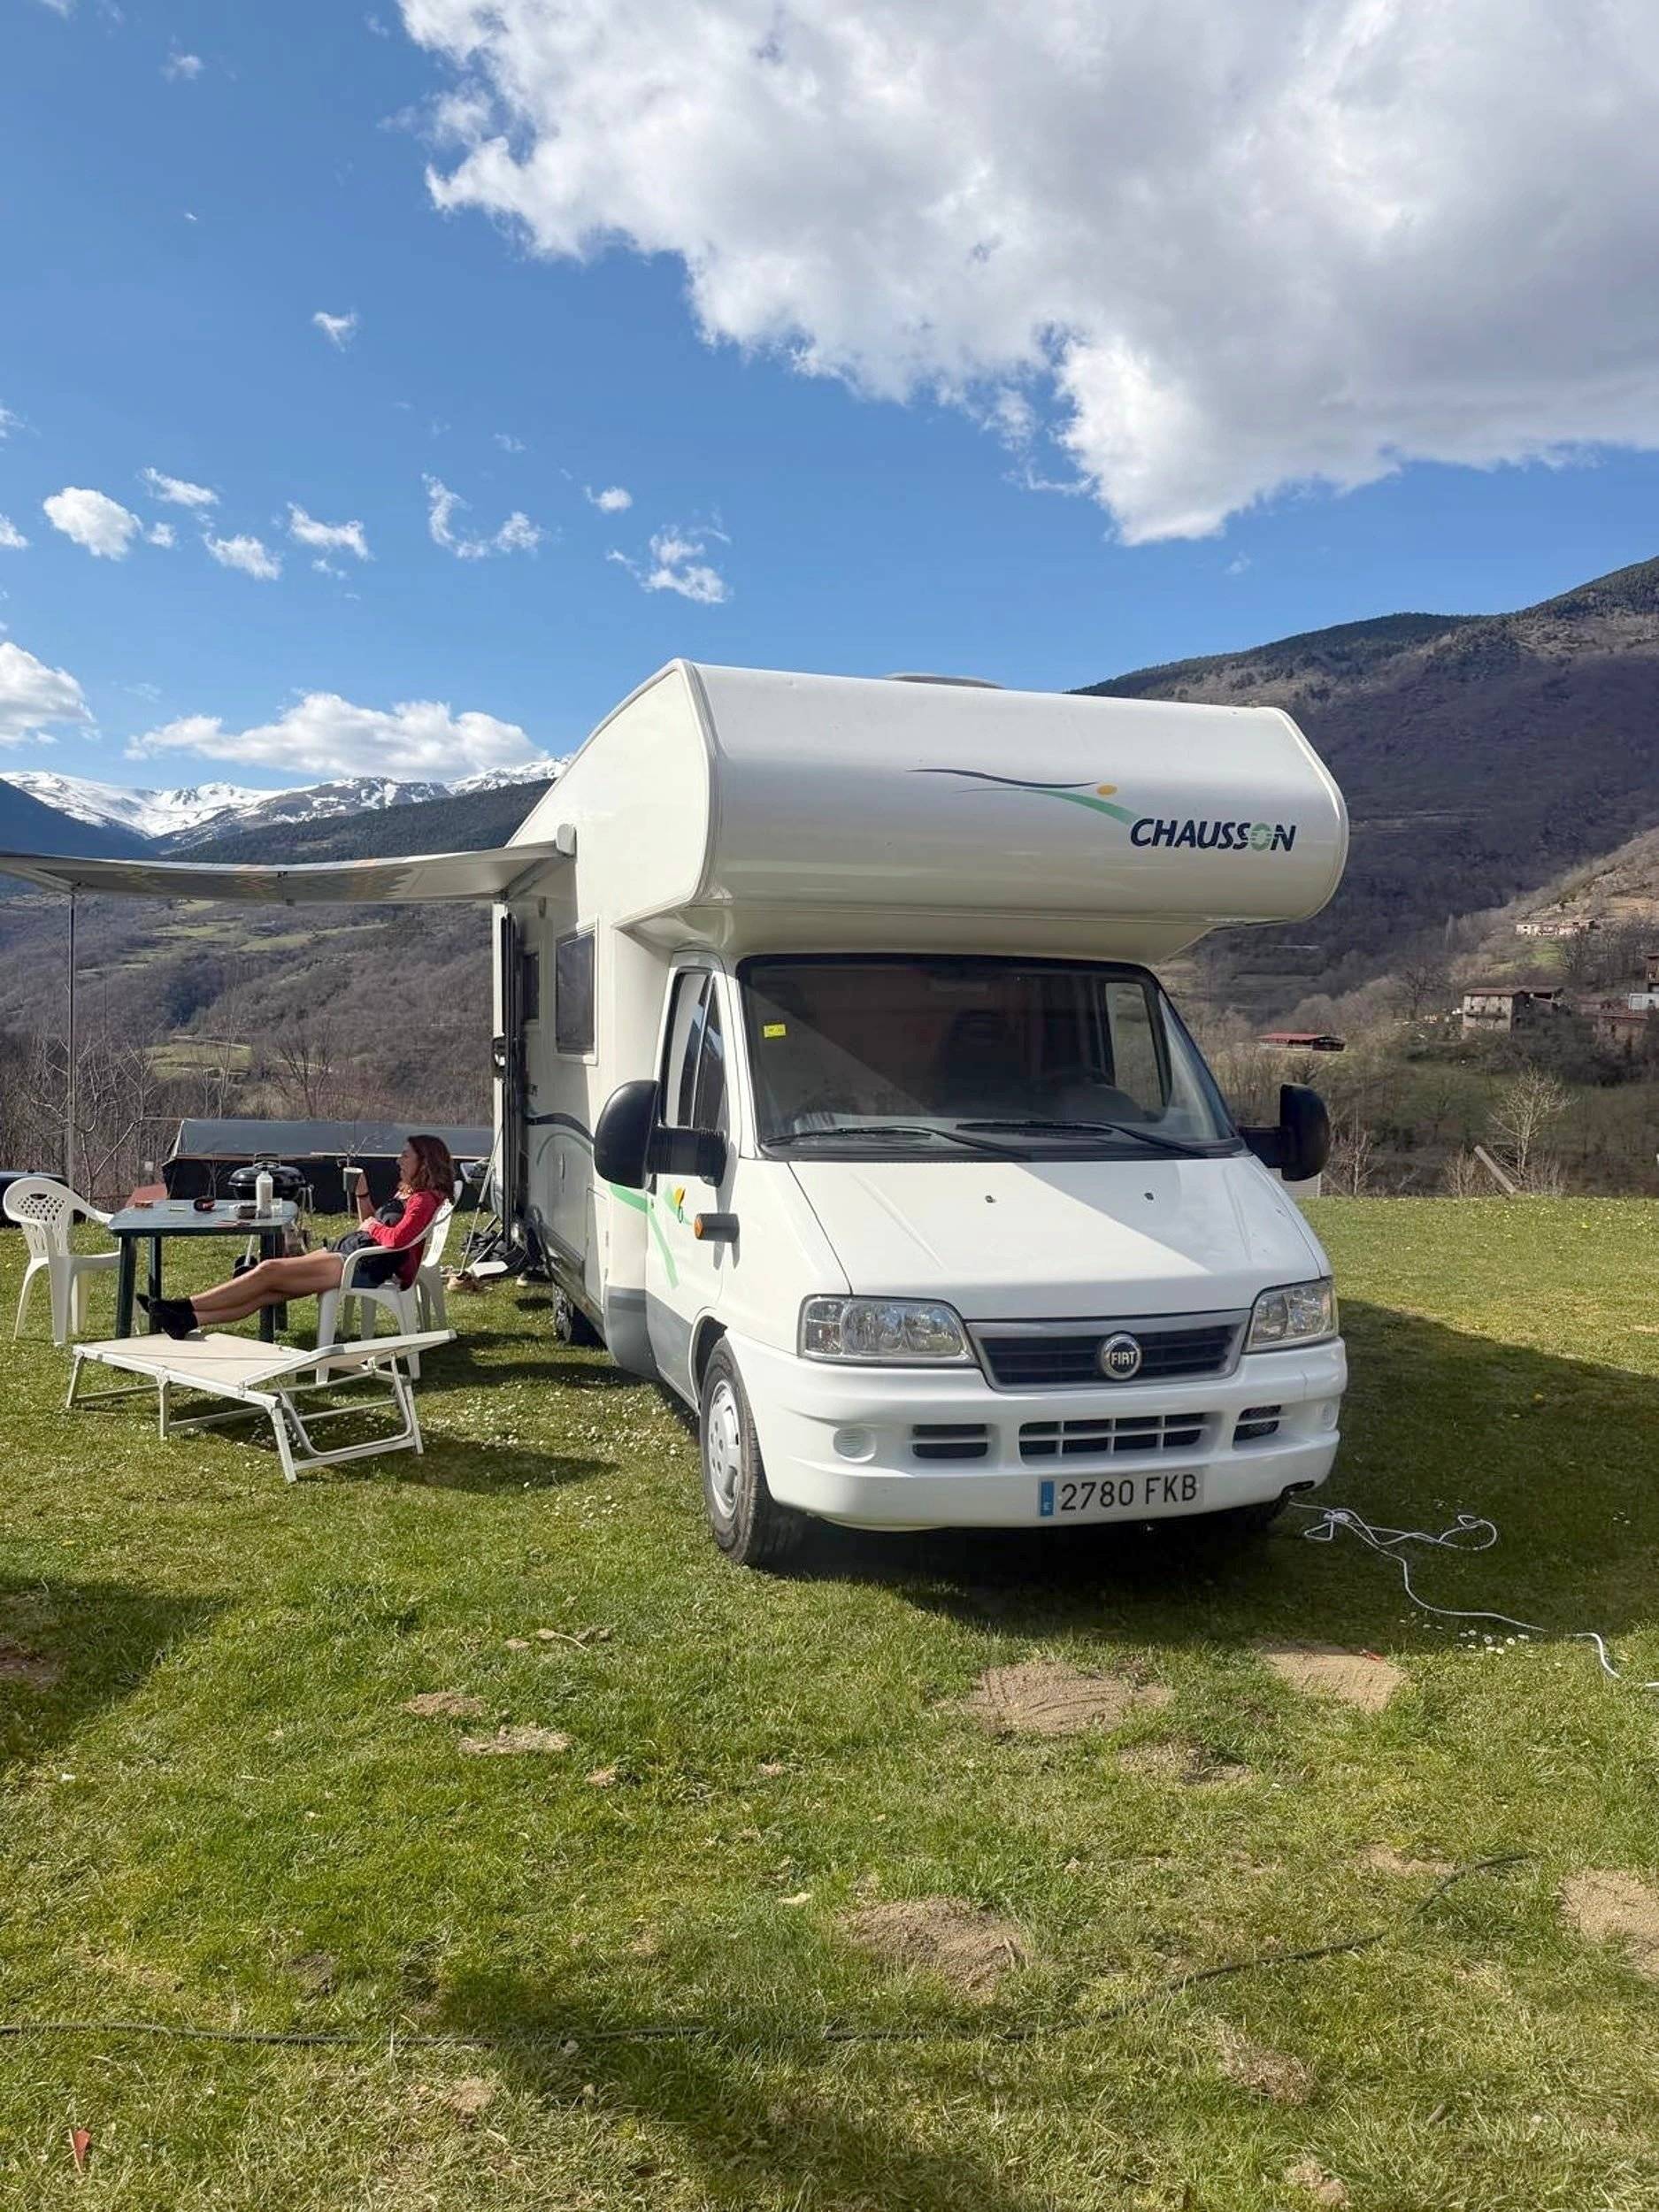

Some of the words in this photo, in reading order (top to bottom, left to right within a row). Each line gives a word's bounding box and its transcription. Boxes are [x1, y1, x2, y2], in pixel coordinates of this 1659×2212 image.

[1131, 818, 1296, 851] CHAUSSON
[1110, 1351, 1136, 1365] FIAT
[1061, 1479, 1134, 1510] 2780
[1146, 1474, 1196, 1504] FKB
